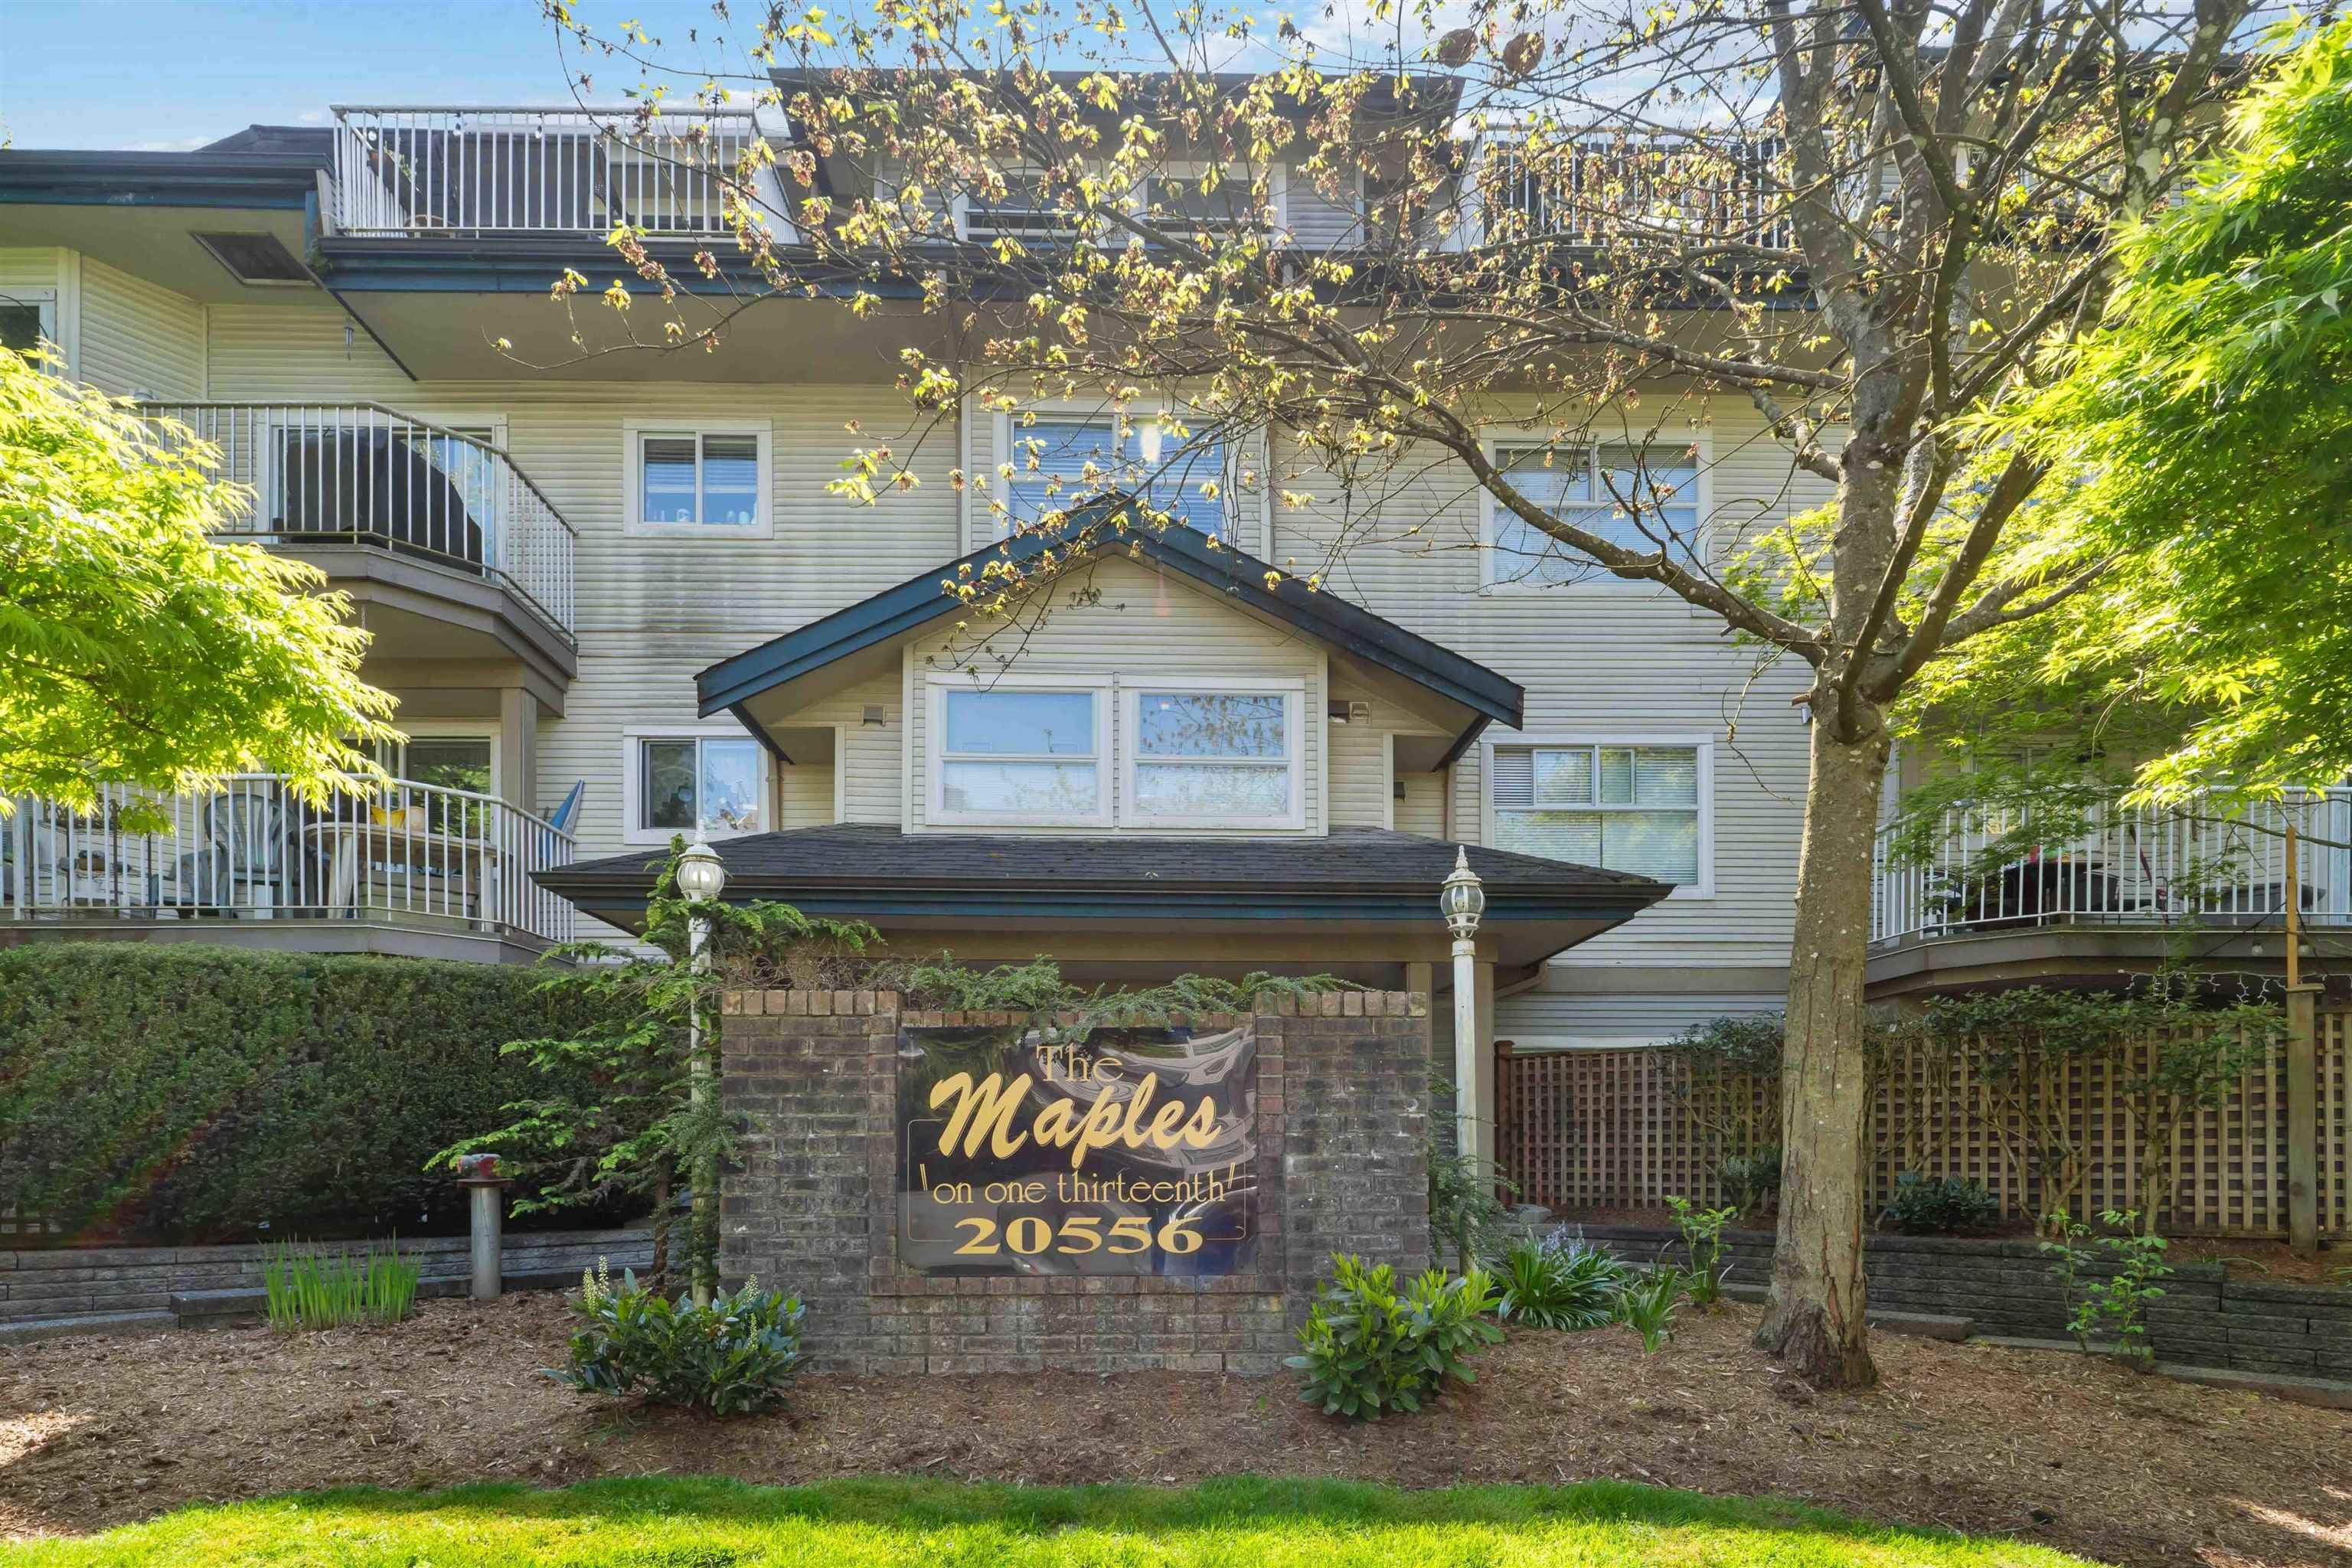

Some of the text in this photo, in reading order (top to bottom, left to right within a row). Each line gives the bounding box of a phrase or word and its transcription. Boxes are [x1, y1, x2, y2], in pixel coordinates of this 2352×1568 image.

[1037, 1044, 1124, 1083] The
[929, 1072, 1223, 1169] Maples
[985, 1182, 1047, 1204] one
[952, 1216, 1204, 1256] 20556
